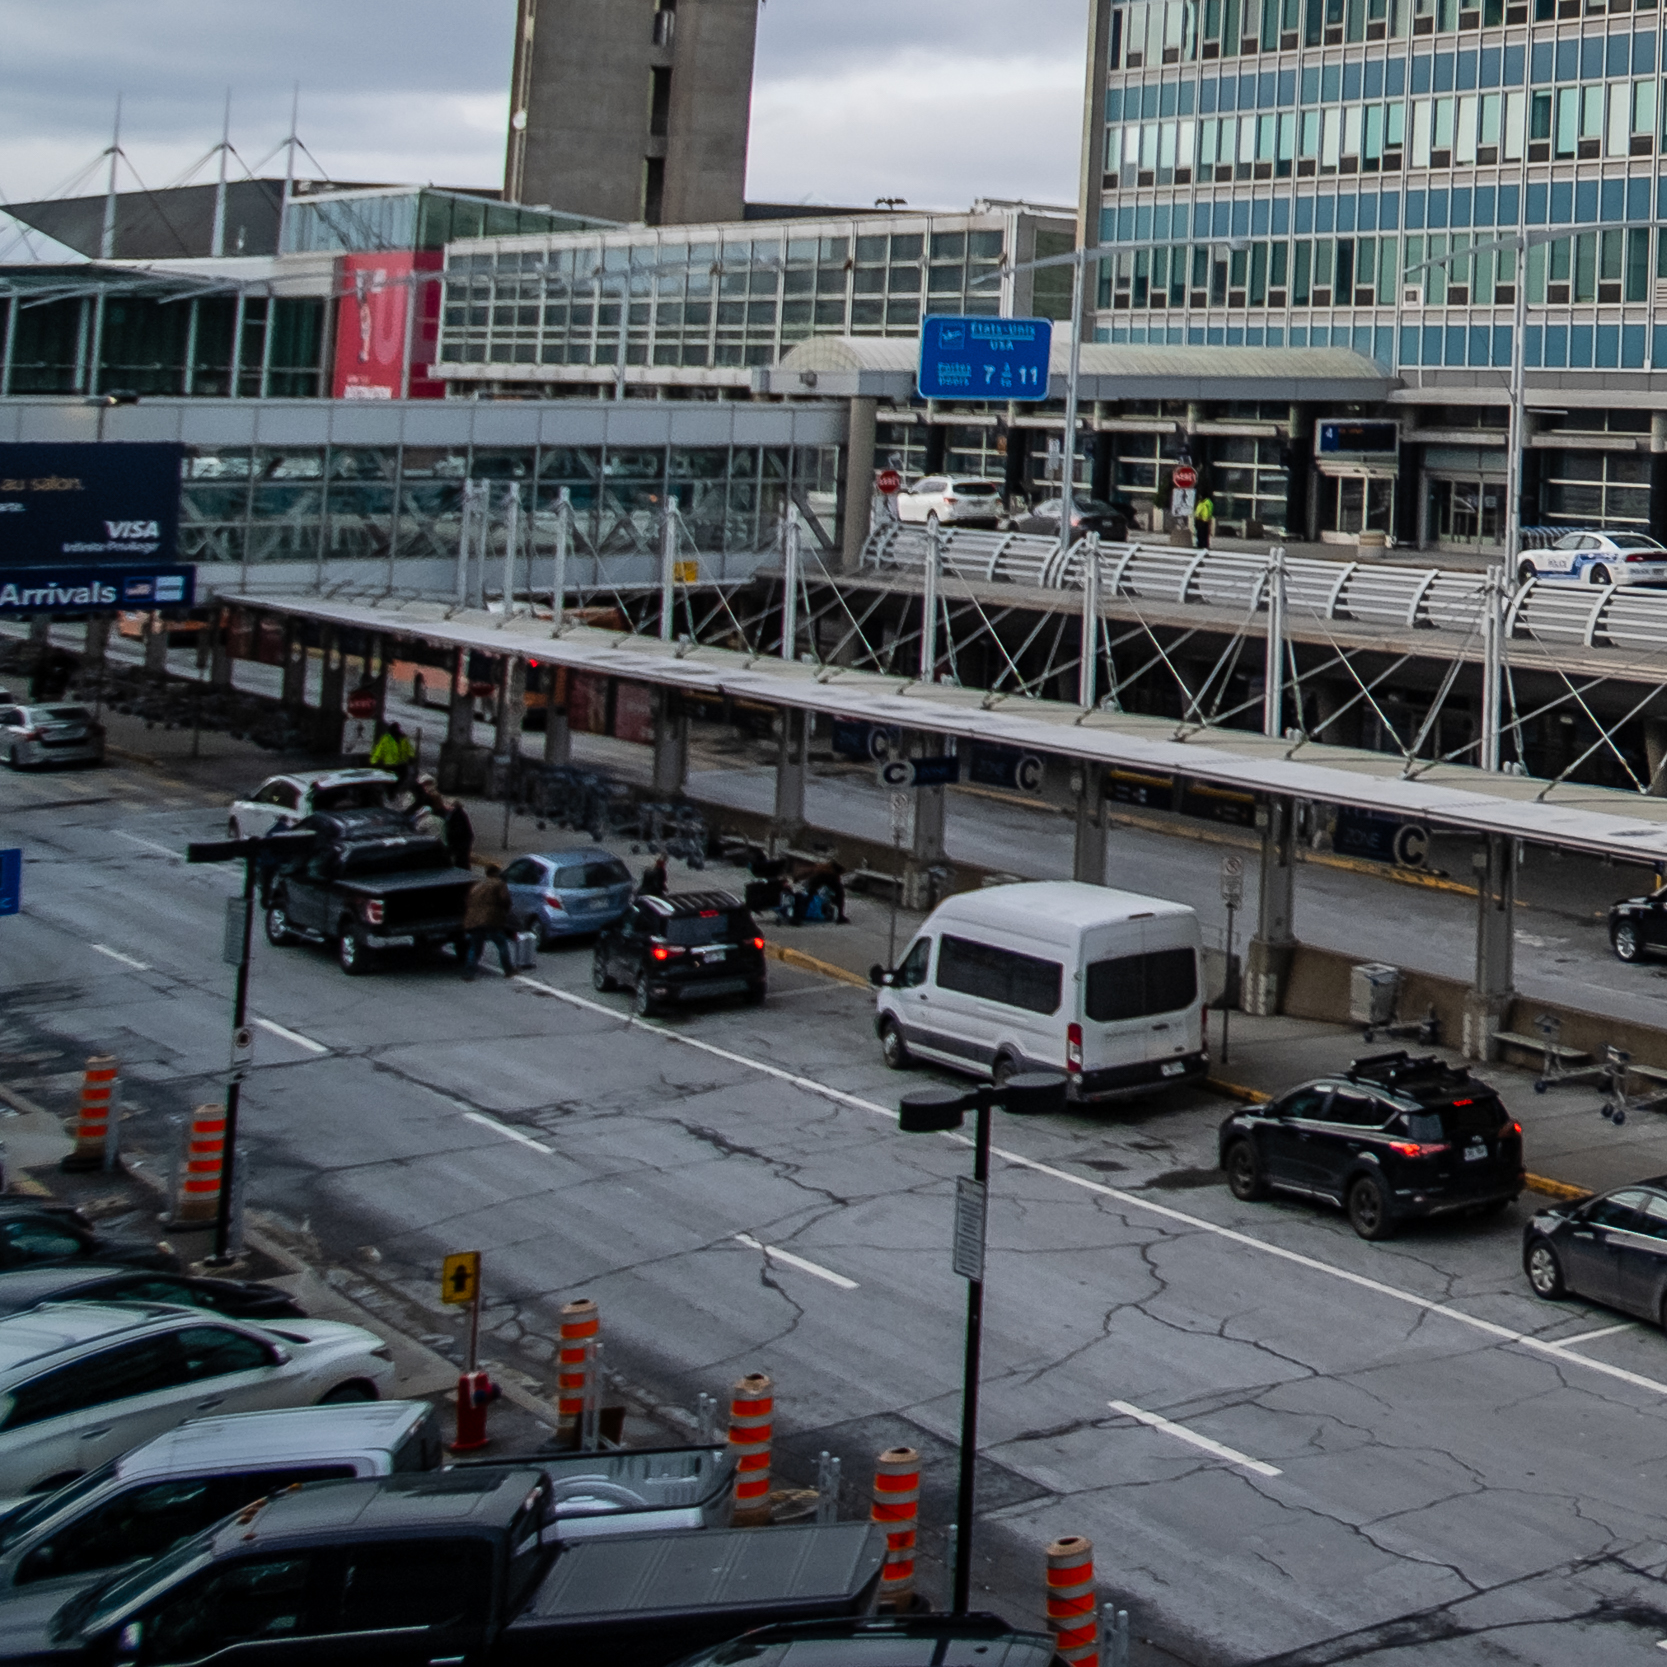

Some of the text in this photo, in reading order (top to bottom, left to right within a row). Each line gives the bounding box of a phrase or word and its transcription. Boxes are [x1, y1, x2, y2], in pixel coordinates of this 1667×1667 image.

[983, 364, 996, 385] 7
[1019, 365, 1038, 386] 11
[105, 521, 159, 538] VISA
[0, 582, 117, 606] Arrivals
[1399, 826, 1425, 866] C
